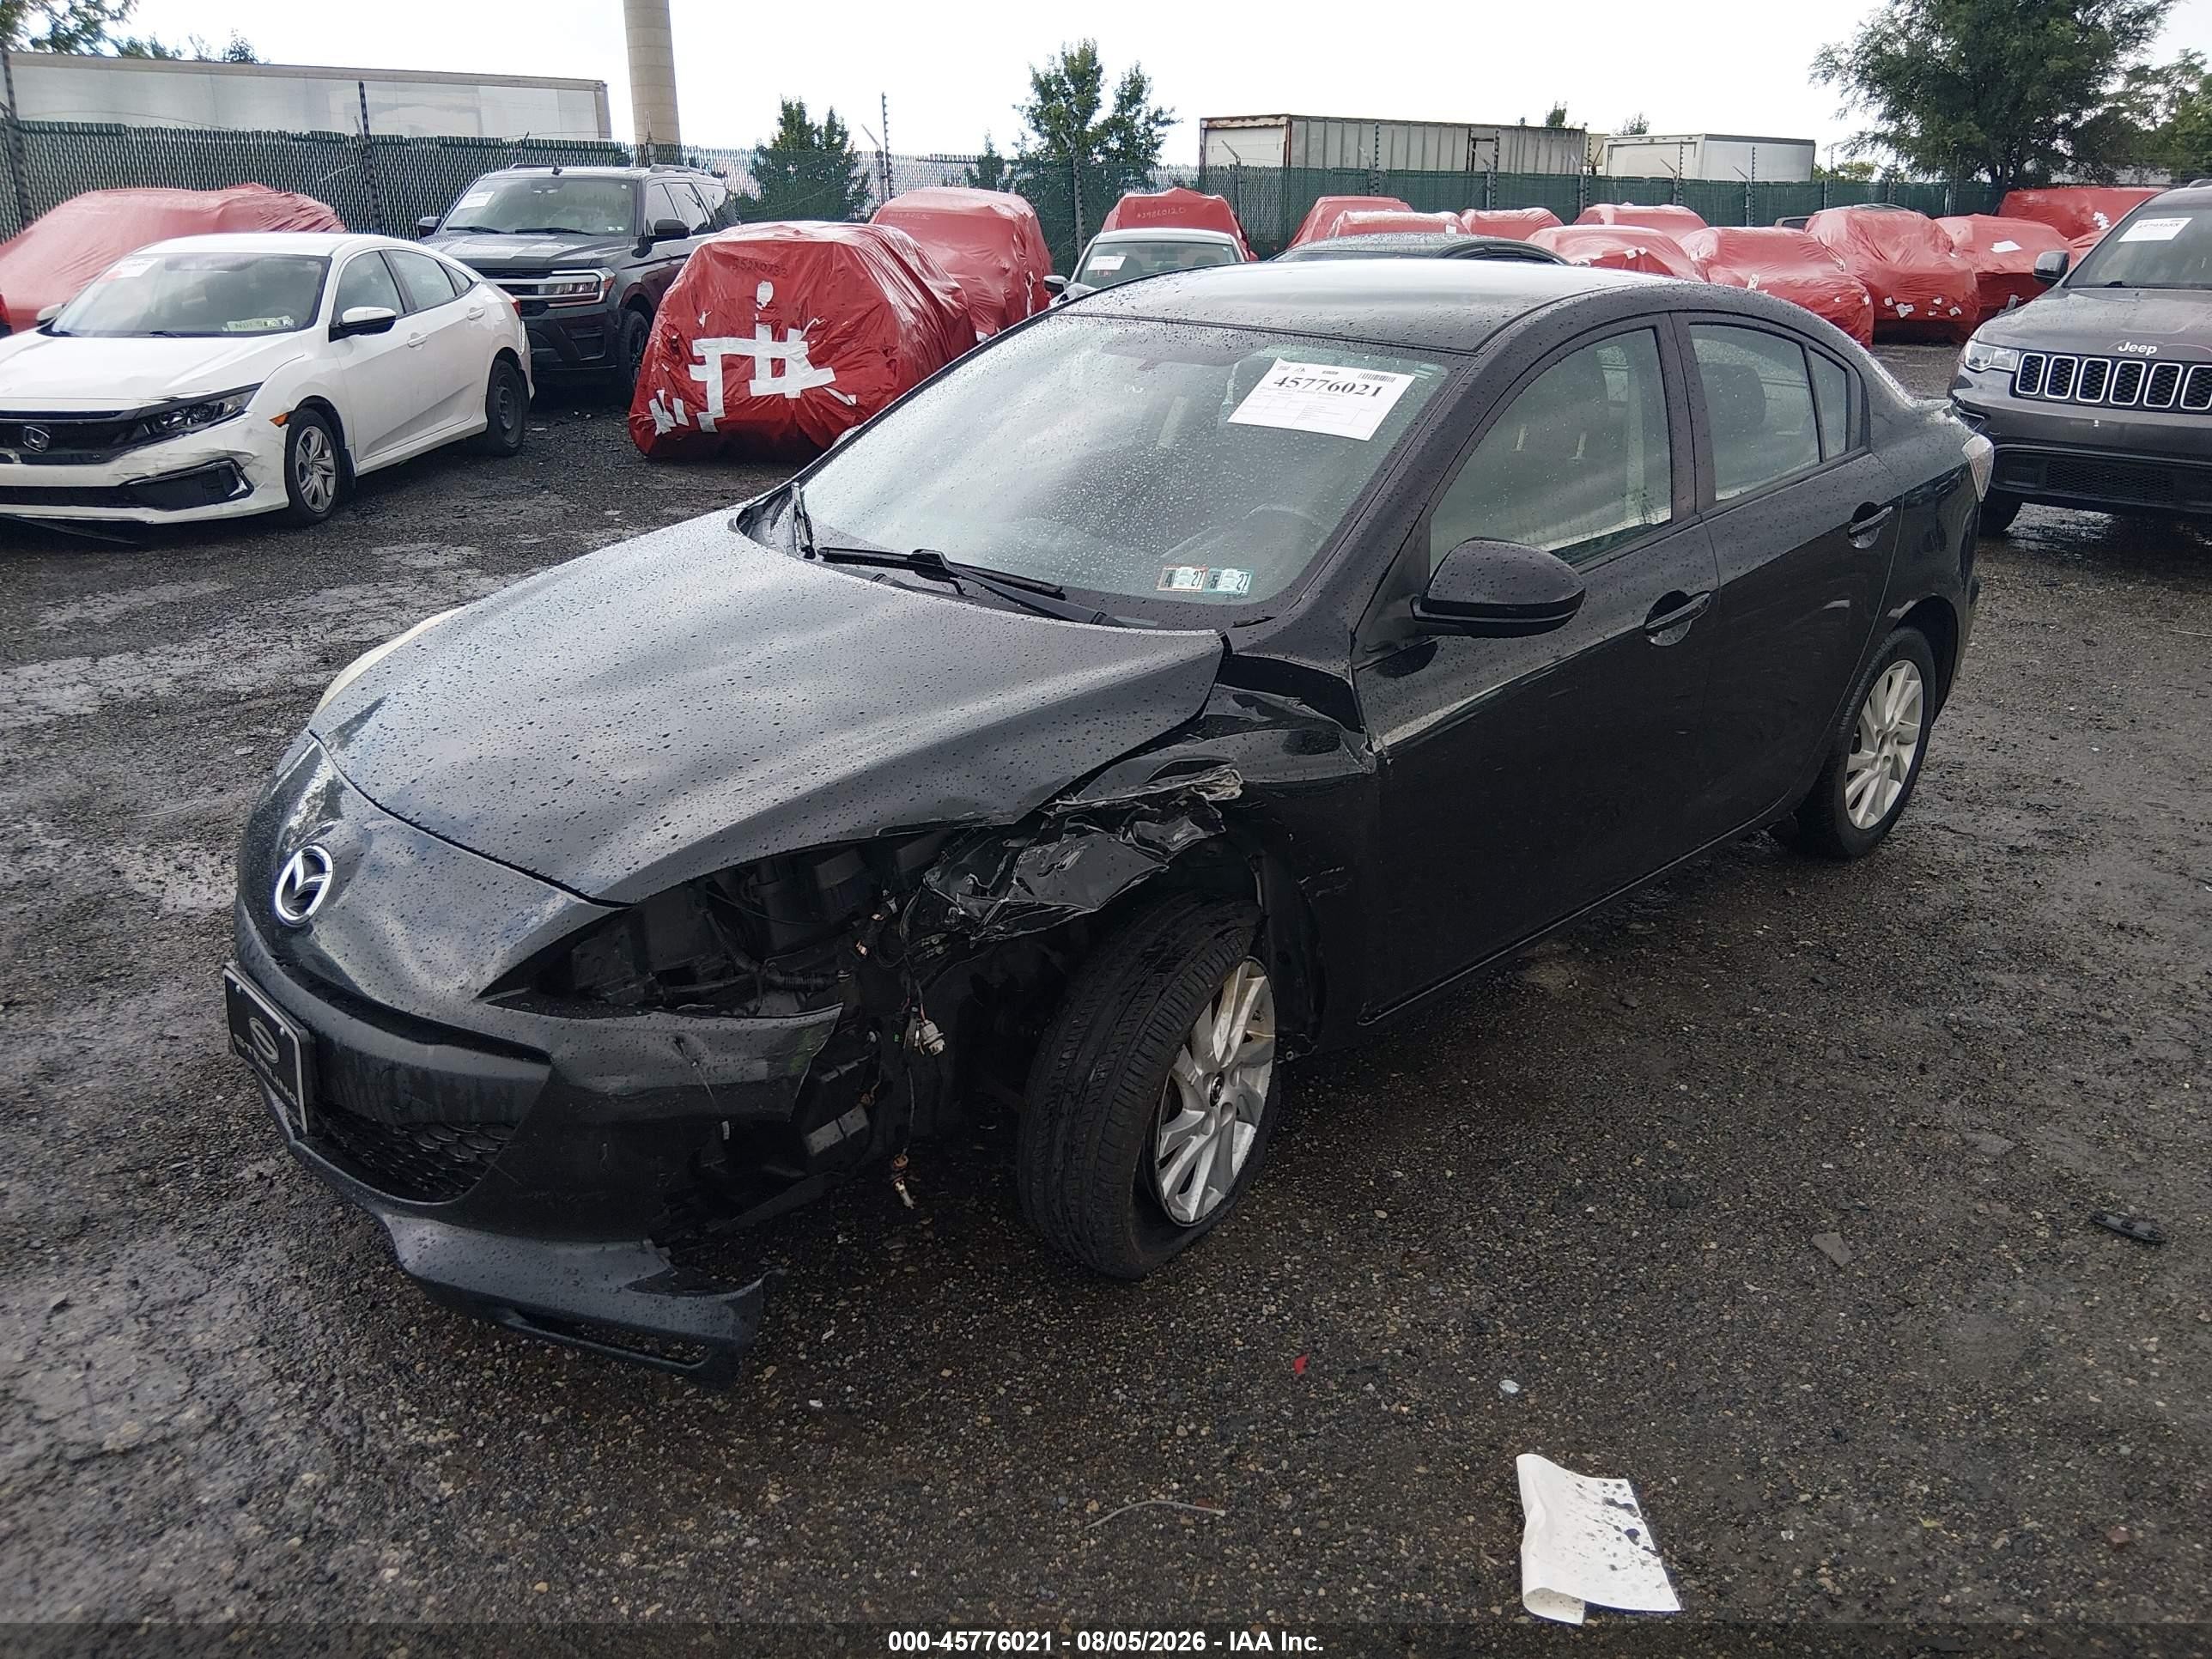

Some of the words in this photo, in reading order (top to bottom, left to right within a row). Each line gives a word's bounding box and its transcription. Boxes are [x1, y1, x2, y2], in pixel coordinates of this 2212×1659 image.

[2118, 342, 2157, 356] Jeep
[1273, 376, 1383, 398] 45776021
[1191, 570, 1204, 586] 27
[1237, 574, 1249, 592] 27
